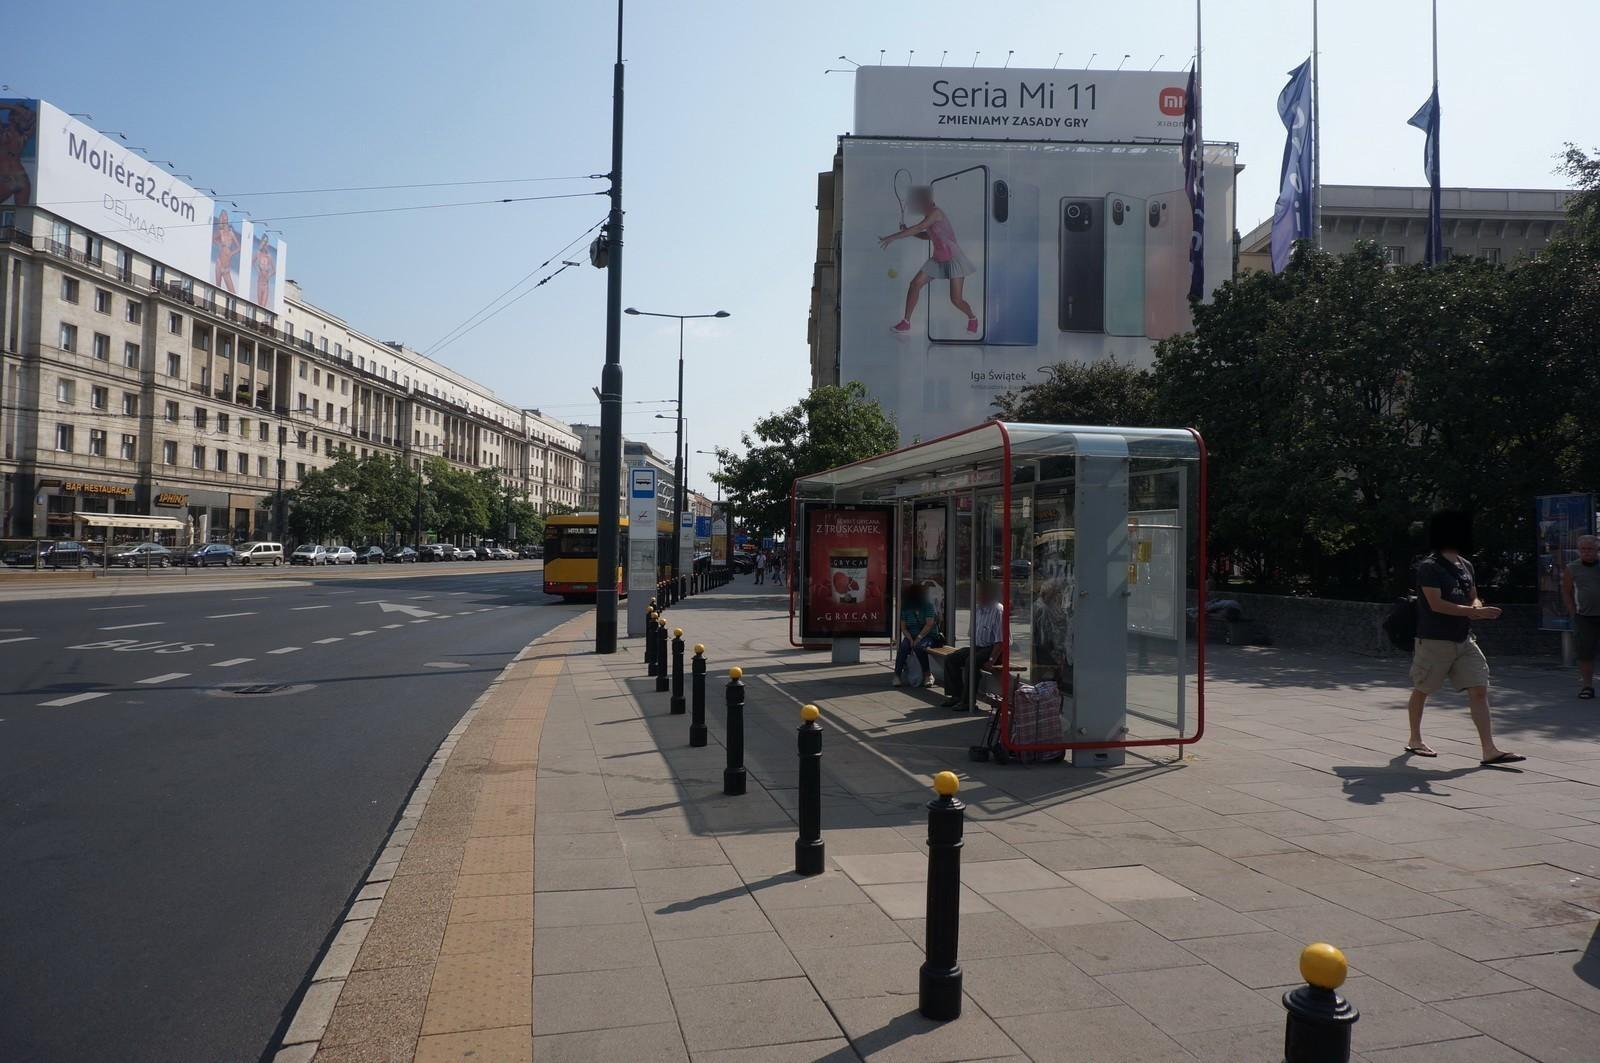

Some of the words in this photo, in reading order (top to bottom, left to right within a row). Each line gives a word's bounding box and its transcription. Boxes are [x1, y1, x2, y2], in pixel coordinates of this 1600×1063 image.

[932, 80, 1007, 108] Seria
[1020, 81, 1054, 109] Mi
[1067, 83, 1096, 110] 11
[938, 115, 1010, 126] ZMIENIAMY
[1012, 116, 1061, 127] ZASADY
[1064, 118, 1089, 128] GRY
[69, 132, 195, 222] Moliera2.com
[103, 193, 165, 241] DELMAAR
[970, 371, 986, 382] Iga
[988, 369, 1026, 382] Świątek
[65, 482, 82, 491] BAR
[824, 612, 877, 621] GRYCAN
[64, 639, 215, 654] BUS
